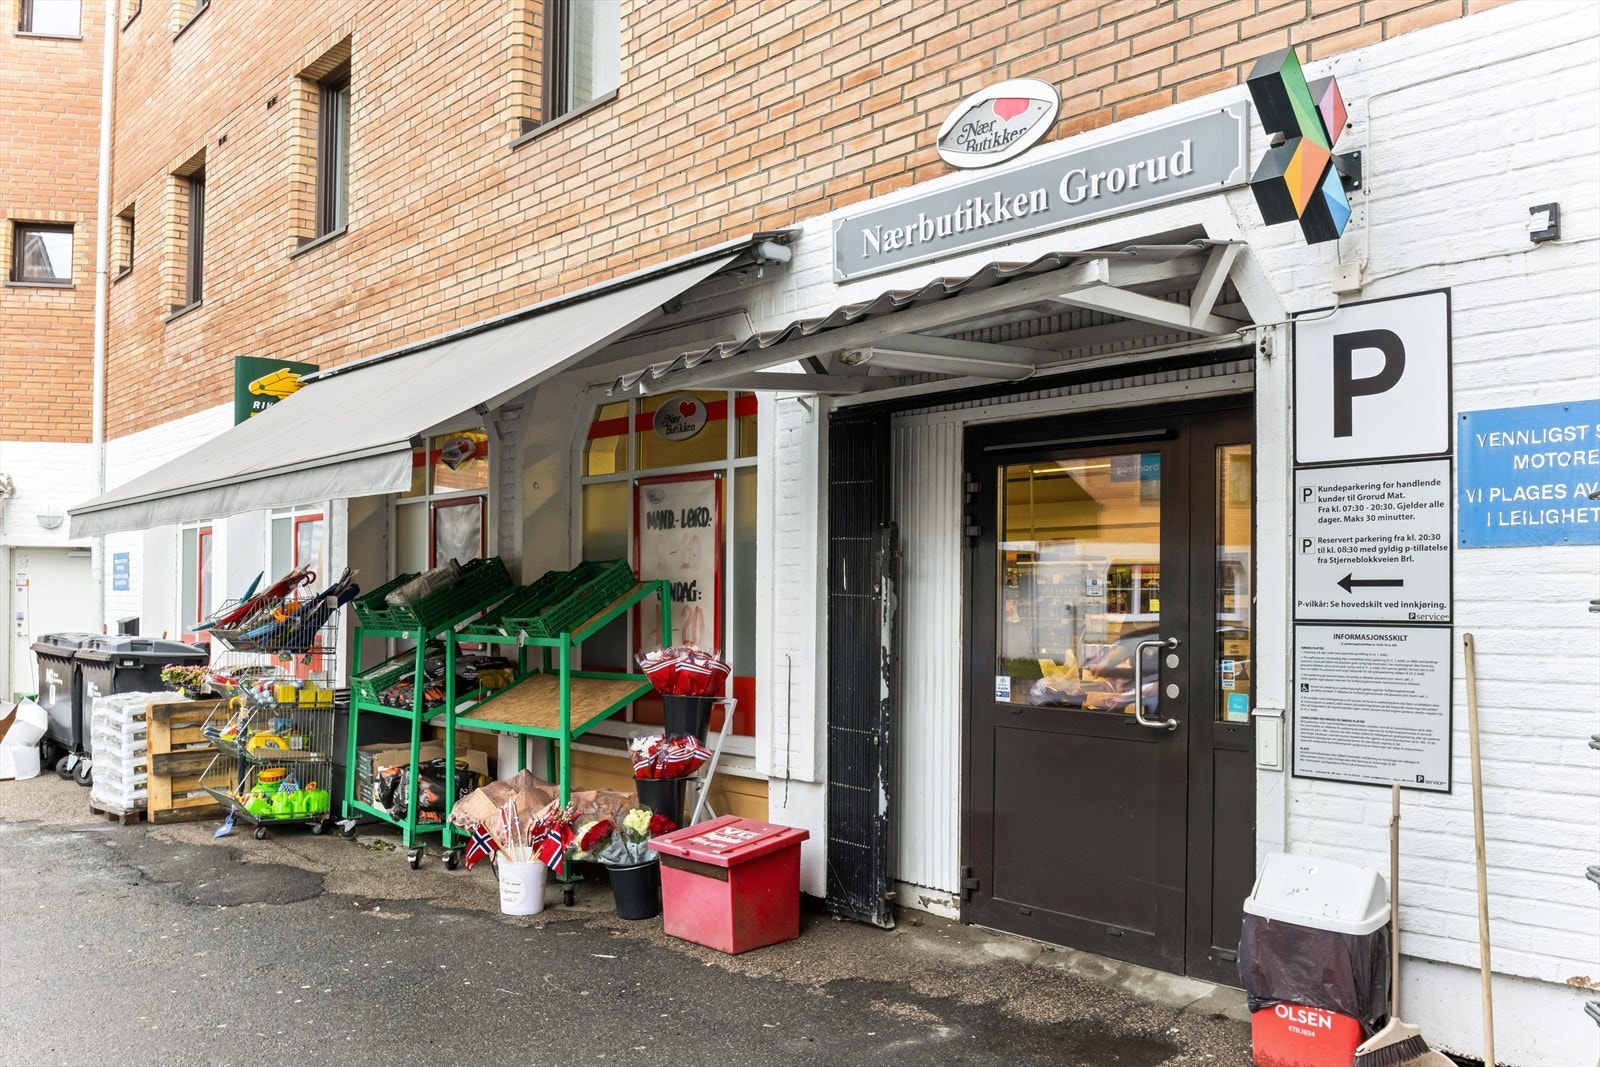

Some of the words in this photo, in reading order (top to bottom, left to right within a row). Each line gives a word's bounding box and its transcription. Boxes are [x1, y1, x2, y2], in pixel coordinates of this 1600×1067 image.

[957, 120, 996, 145] Nær
[862, 187, 1048, 258] Nærbutikken
[1058, 140, 1193, 204] Grorud
[1333, 328, 1406, 438] P
[1476, 424, 1590, 448] VENNLIGST
[1318, 482, 1381, 492] Kundeparkering
[1383, 482, 1394, 490] for
[1397, 479, 1441, 488] handlende
[1466, 488, 1482, 503] VI
[1490, 484, 1567, 502] PLAGES
[1397, 501, 1428, 511] Gjelder
[1318, 516, 1342, 525] dager.
[1487, 512, 1490, 526] I
[1499, 508, 1600, 526] LEILIGHET
[1354, 535, 1392, 544] parkering
[1378, 545, 1403, 554] gyldig
[1405, 544, 1448, 553] p-tillatelse
[1330, 556, 1399, 565] Stjerneblokkveien
[1401, 601, 1447, 610] innkjøring.
[1275, 1004, 1332, 1030] OLSEN
